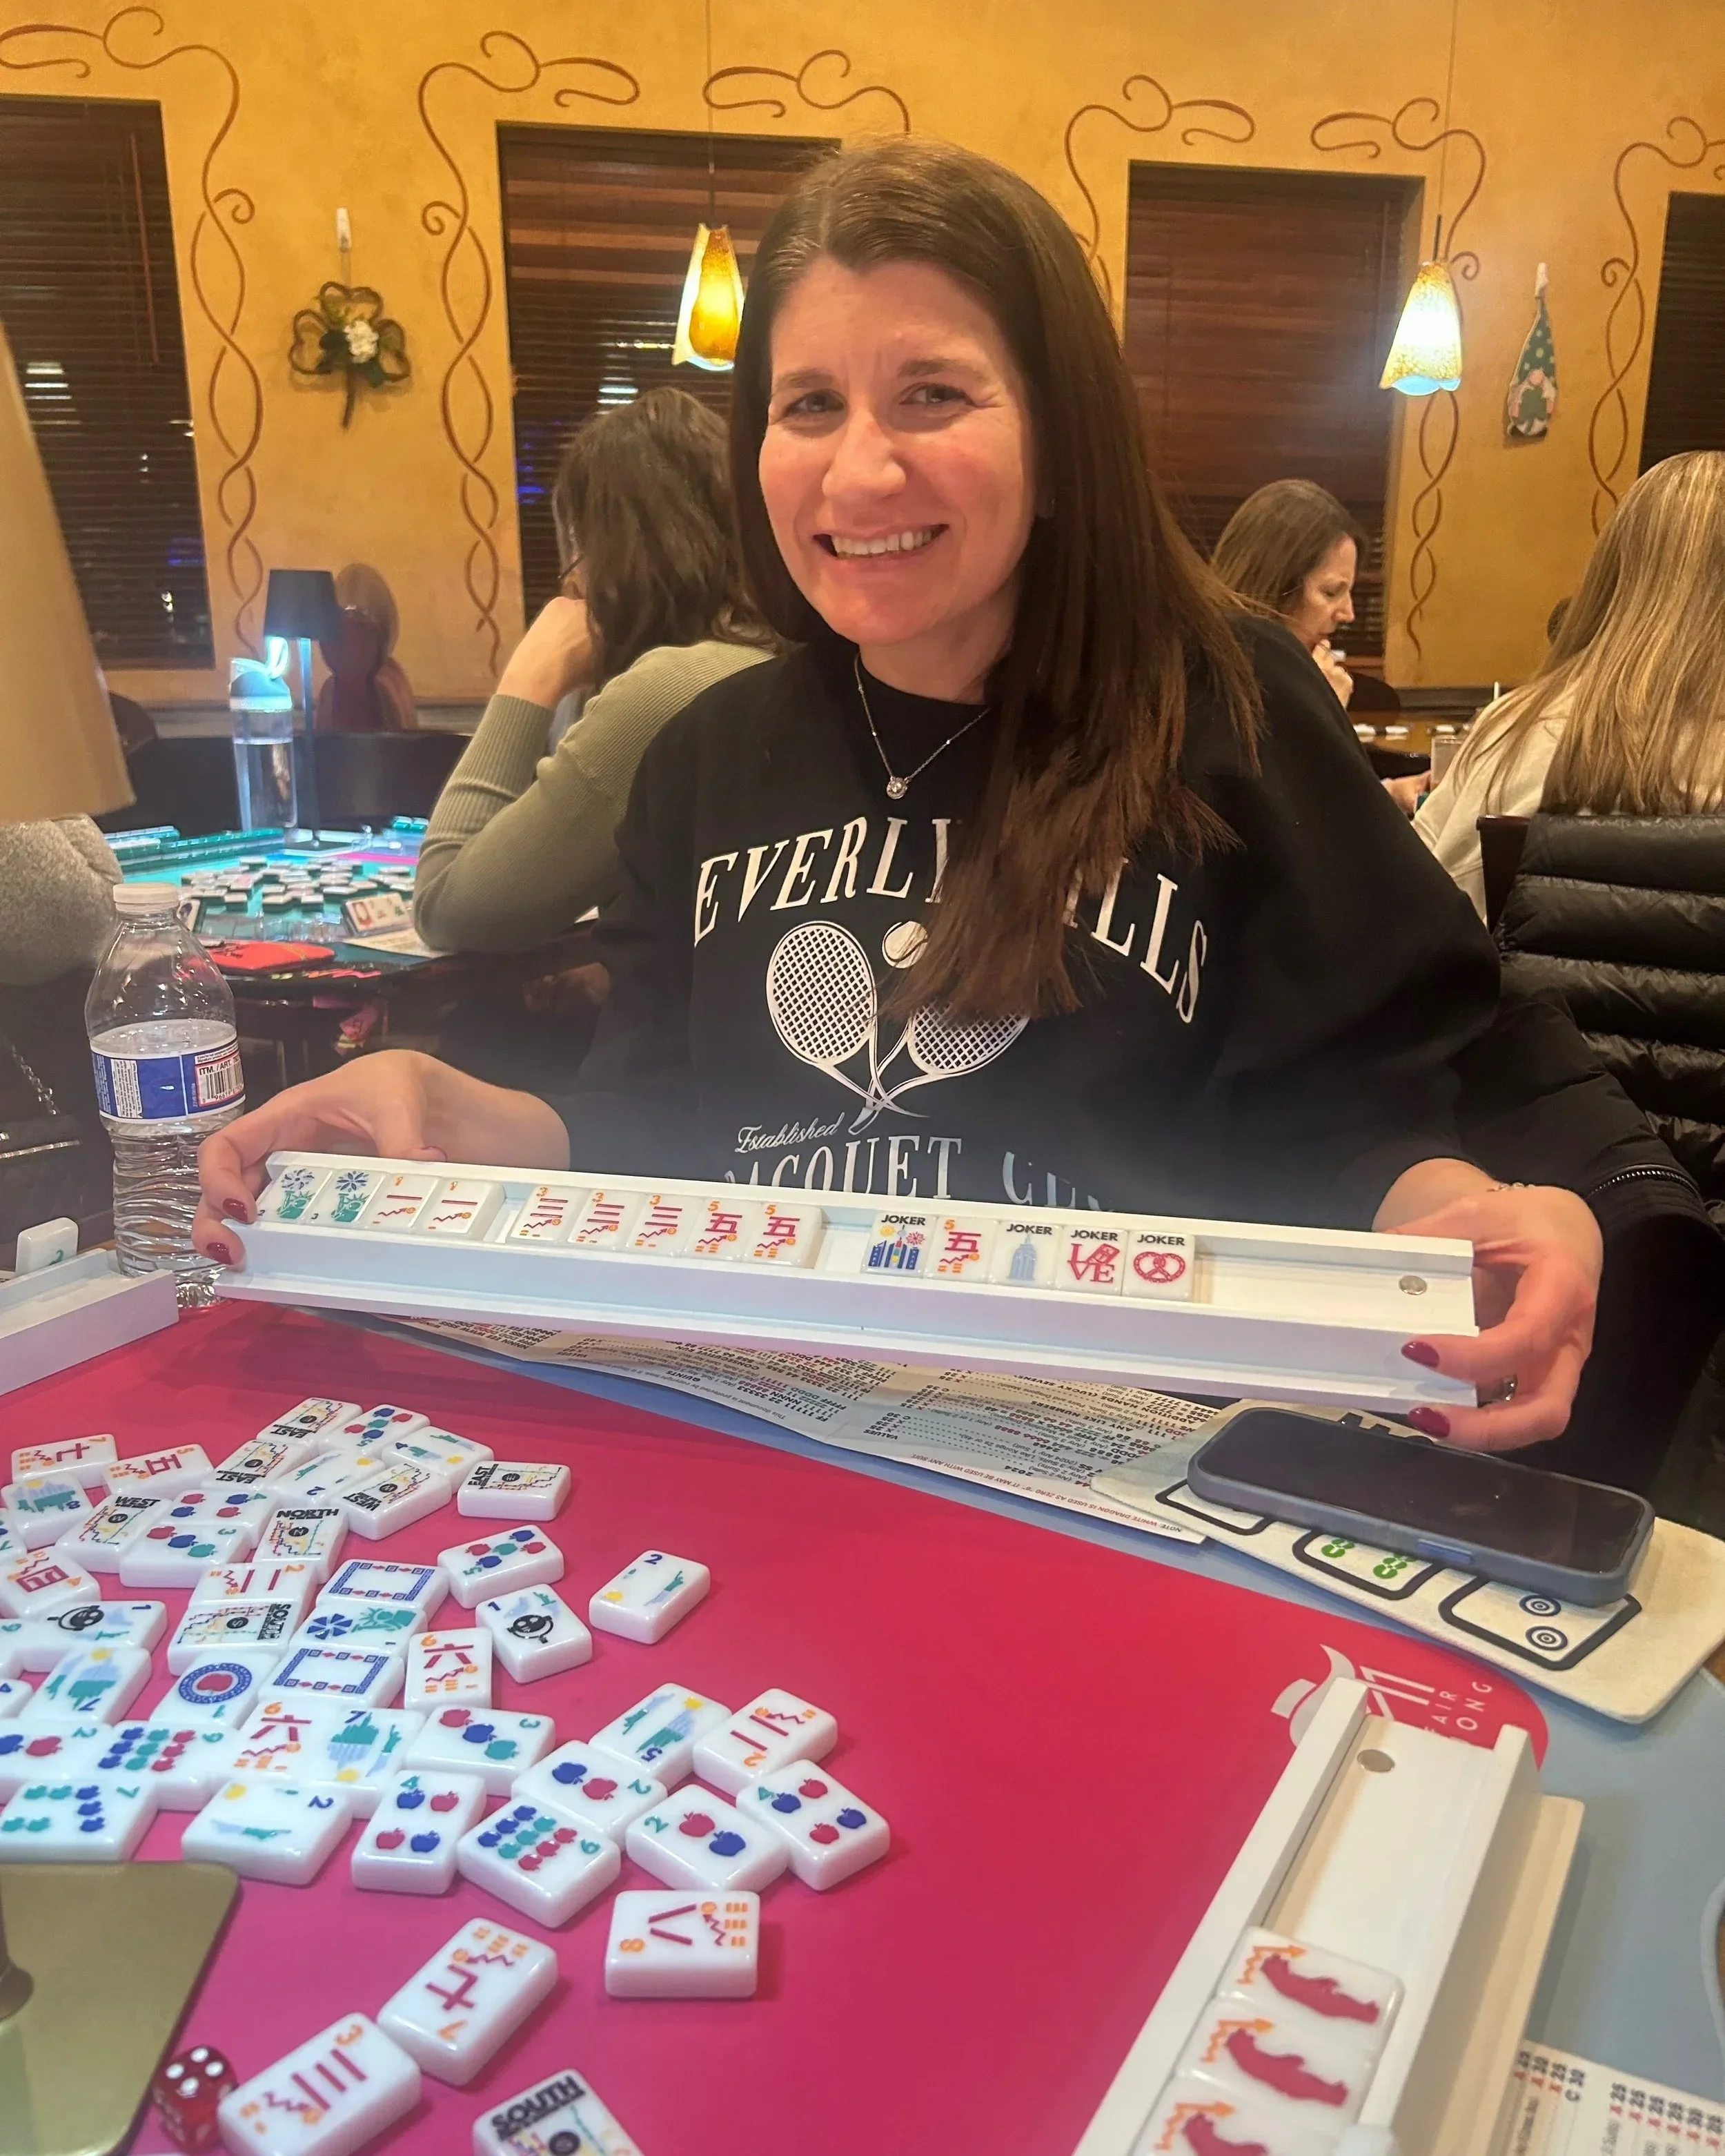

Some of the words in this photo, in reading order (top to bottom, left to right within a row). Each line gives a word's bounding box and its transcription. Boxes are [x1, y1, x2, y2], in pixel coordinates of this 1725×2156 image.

[199, 1066, 215, 1075] ITM.
[220, 1059, 232, 1069] ART.
[734, 1112, 845, 1154] Established
[395, 1177, 403, 1186] 1
[536, 1187, 549, 1197] 3
[592, 1193, 604, 1202] 3
[649, 1195, 662, 1205] 3
[708, 1202, 720, 1211] 5
[765, 1205, 777, 1215] 5
[704, 1213, 742, 1233] 五
[881, 1215, 926, 1226] JOKER
[944, 1219, 955, 1230] 5
[763, 1217, 800, 1237] 五
[1007, 1224, 1052, 1236] JOKER
[1071, 1230, 1118, 1241] JOKER
[1138, 1235, 1185, 1246] JOKER
[945, 1232, 981, 1252] 五
[695, 1351, 760, 1370] CONSECUTIVE
[665, 1371, 700, 1382] QUINTS
[790, 1387, 820, 1400] DDDD
[1057, 1385, 1098, 1397] (LUCKY
[769, 1391, 802, 1405] NNNN
[1100, 1395, 1138, 1409] HANDS
[1030, 1400, 1081, 1418] NUMBERS
[1082, 1415, 1106, 1424] LIKE
[1141, 1407, 1194, 1424] ADDITION
[270, 1424, 308, 1438] EAST
[863, 1429, 898, 1440] VALUES
[1032, 1442, 1060, 1453] 2468
[944, 1462, 963, 1471] WITH
[1004, 1465, 1034, 1477] 2024
[217, 1471, 256, 1484] EAST
[467, 1465, 491, 1487] EAST
[994, 1477, 1012, 1485] MAY
[307, 1486, 326, 1496] 2
[115, 1496, 161, 1507] WEST
[342, 1492, 381, 1511] WEST
[276, 1508, 339, 1518] NORTH
[1097, 1506, 1131, 1518] DRAGON
[1132, 1516, 1157, 1526] WHITE
[644, 1554, 663, 1565] 2
[259, 1603, 292, 1640] SOUTH
[421, 1634, 437, 1647] 6
[264, 1702, 282, 1714] 6
[640, 1746, 662, 1763] 5
[308, 1796, 334, 1809] 2
[644, 1816, 669, 1835] 2
[620, 1937, 646, 1952] 8
[335, 2024, 364, 2046] 3
[437, 2020, 469, 2041] 7
[491, 2075, 586, 2131] SOUTH
